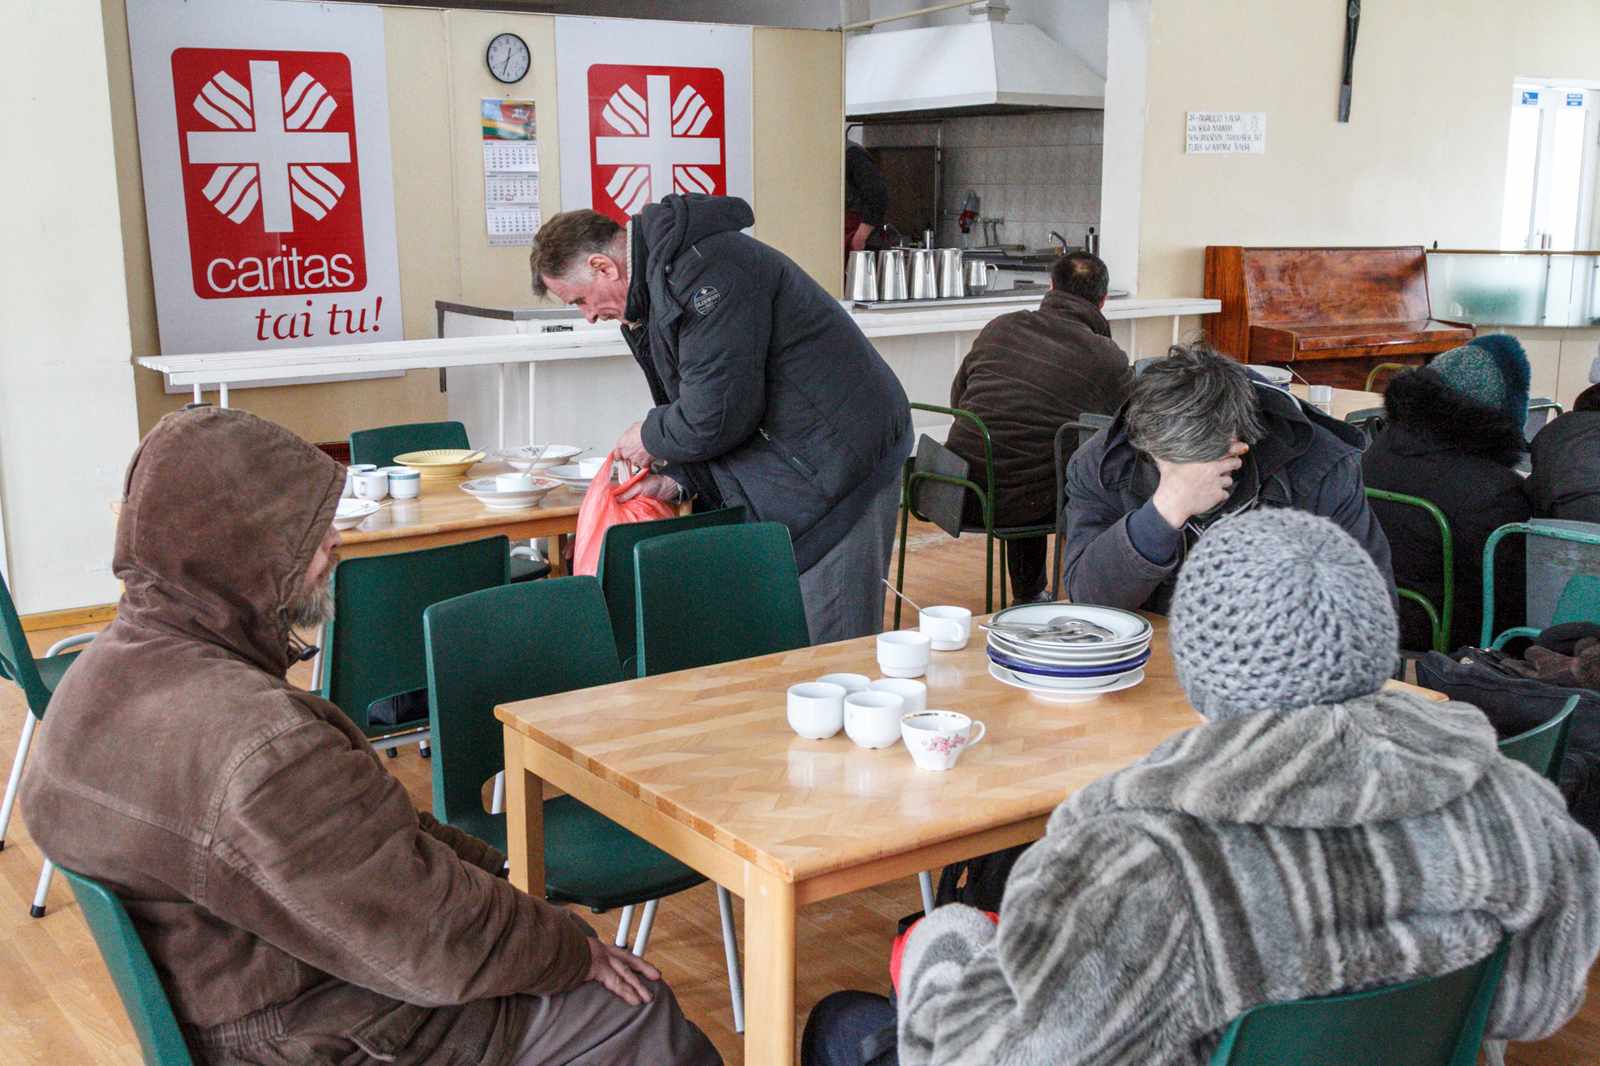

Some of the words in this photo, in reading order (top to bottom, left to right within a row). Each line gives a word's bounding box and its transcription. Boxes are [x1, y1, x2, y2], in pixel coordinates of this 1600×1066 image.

[207, 244, 355, 293] caritas
[255, 300, 314, 341] tai
[327, 296, 382, 336] tu!
